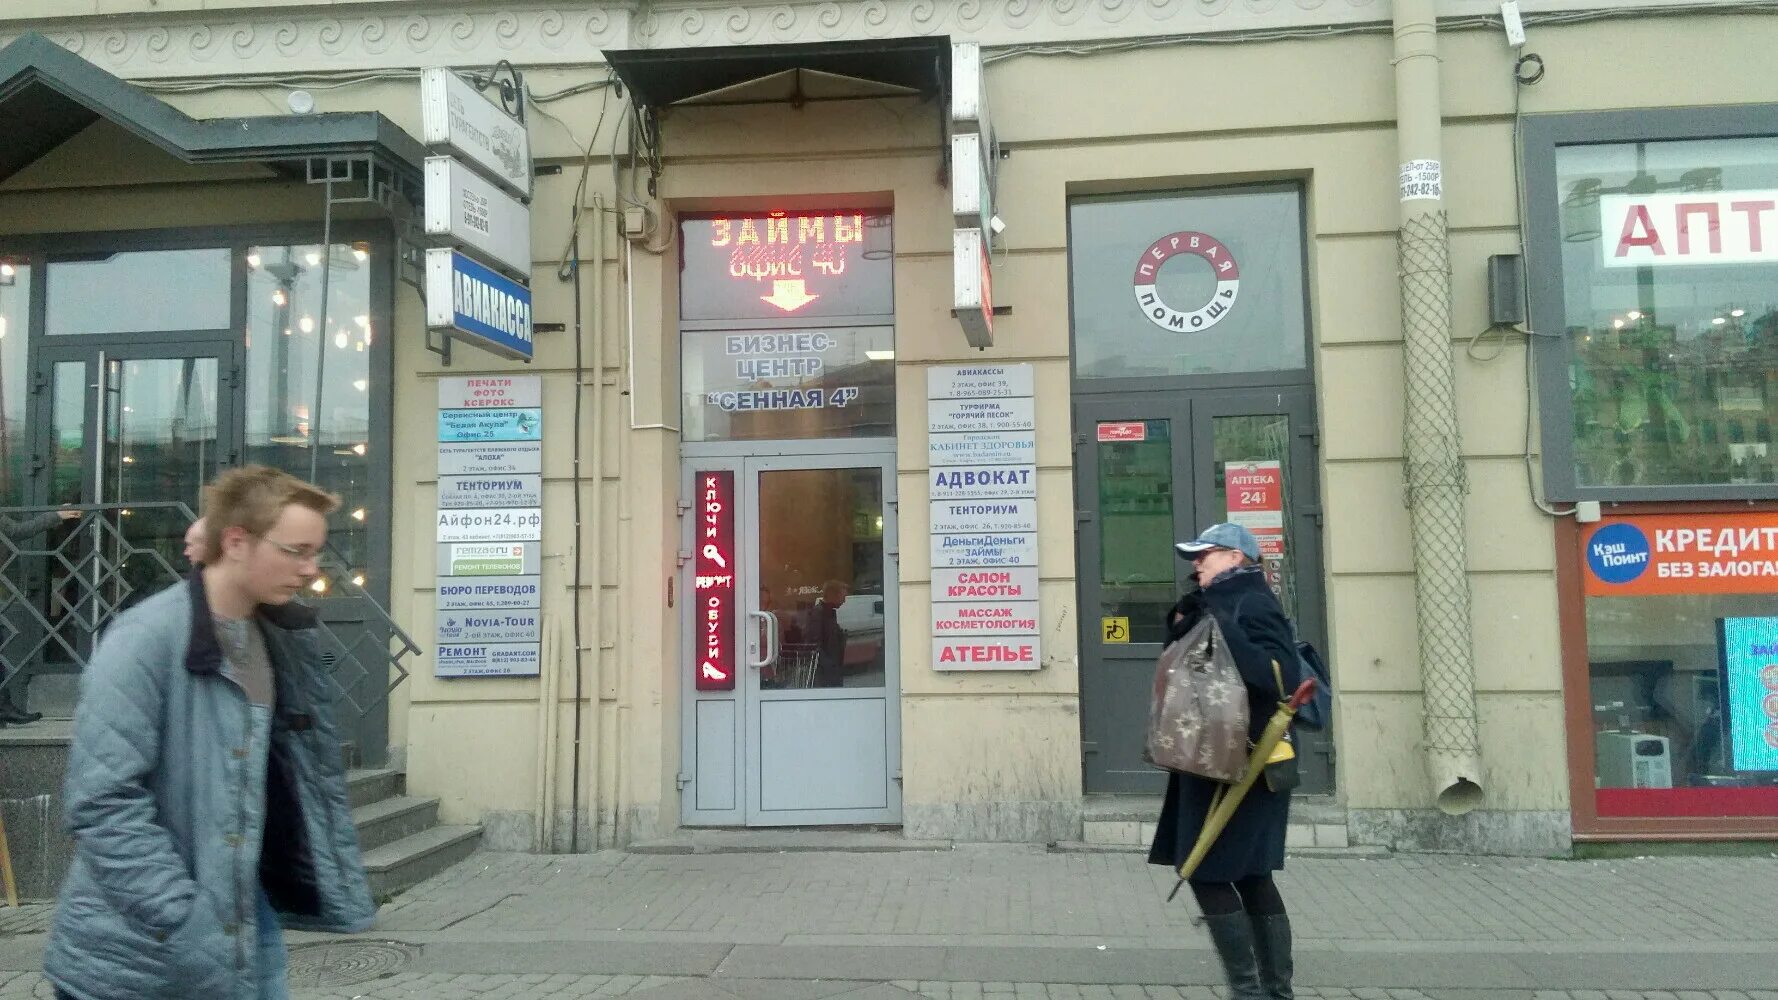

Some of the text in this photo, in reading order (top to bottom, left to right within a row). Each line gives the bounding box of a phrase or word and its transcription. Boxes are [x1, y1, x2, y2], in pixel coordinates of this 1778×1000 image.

[711, 211, 864, 247] ЗАЙМЫ
[1614, 200, 1776, 258] АПТ
[1139, 236, 1233, 276] ПЕРВАЯ
[453, 269, 532, 343] АВИАКАССА
[1141, 288, 1233, 329] ПОМОЩЬ
[726, 333, 837, 355] БИЗНЕС-
[736, 357, 823, 382] ЦЕНТР
[956, 368, 1004, 376] АВИАКАССЫ
[467, 379, 512, 388] ПЕЧАТИ
[997, 380, 1009, 388] 39,
[474, 389, 505, 397] ФОТО
[464, 398, 514, 407] КСЕРОКС
[959, 403, 1001, 411] ТУРФИРМА
[442, 411, 491, 420] Сервисный
[457, 431, 482, 440] Офис
[930, 440, 1034, 451] КАБИНЕТ ЗДОРОВЬЯ
[936, 469, 1030, 489] АДВОКАТ
[1231, 475, 1275, 485] АПТЕКА
[456, 480, 523, 491] ТЕНТОРИУМ
[1240, 491, 1262, 505] 24
[705, 476, 722, 539] КЛЮЧИ
[949, 504, 1018, 516] ТЕНТОРИУМ
[438, 513, 540, 528] Айфон24.рф
[942, 536, 1026, 548] ДеньгиДеньги
[1655, 528, 1778, 559] КРЕДИТ
[964, 547, 1002, 557] ЗАЙМЫ
[1593, 542, 1626, 558] Кэш
[956, 558, 980, 566] ЭТАЖ,
[1008, 556, 1020, 564] 40
[1602, 550, 1648, 568] Поинт
[1657, 562, 1694, 579] БЕЗ
[958, 572, 1011, 584] САЛОН
[440, 584, 536, 596] БЮРО ПЕРЕВОДОВ
[948, 584, 1022, 597] КРАСОТЫ
[958, 608, 1012, 618] МАССАЖ
[936, 620, 1036, 630] КОСМЕТОЛОГИЯ
[438, 646, 487, 657] РЕМОНТ
[939, 645, 1034, 663] АТЕЛЬЕ
